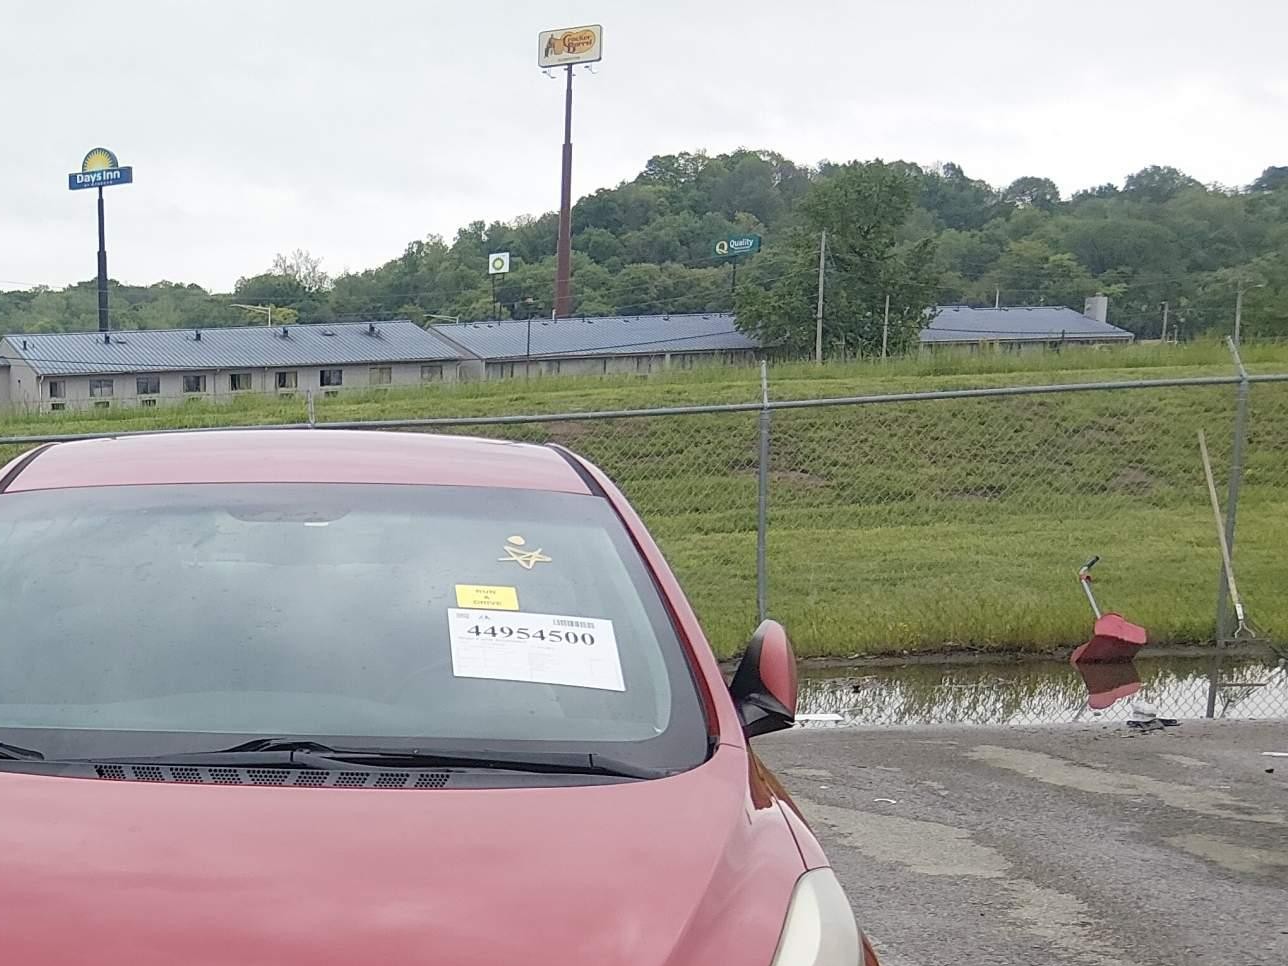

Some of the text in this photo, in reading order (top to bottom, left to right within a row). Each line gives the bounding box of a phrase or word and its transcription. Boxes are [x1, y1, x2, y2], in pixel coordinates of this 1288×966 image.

[76, 172, 101, 185] Days
[103, 170, 121, 181] Inn
[729, 238, 754, 249] Quality
[467, 625, 595, 646] 44954500
